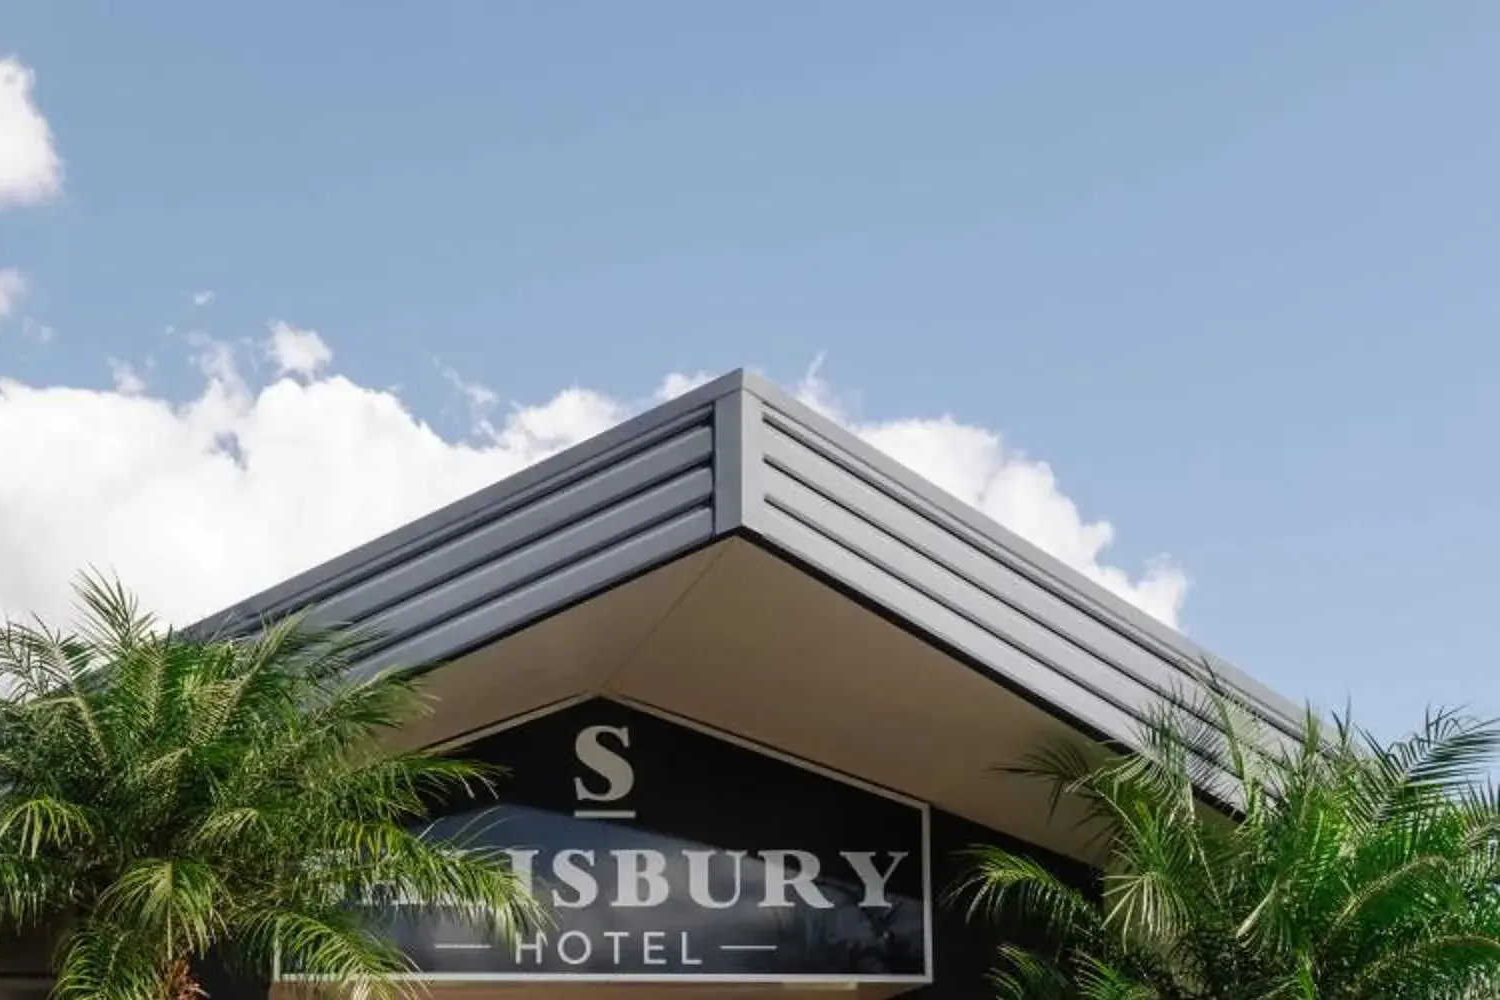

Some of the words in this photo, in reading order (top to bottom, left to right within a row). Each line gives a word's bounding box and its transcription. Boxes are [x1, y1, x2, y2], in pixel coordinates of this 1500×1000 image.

[574, 725, 635, 802] S
[303, 848, 908, 908] ISBURY
[514, 930, 703, 966] HOTEL
